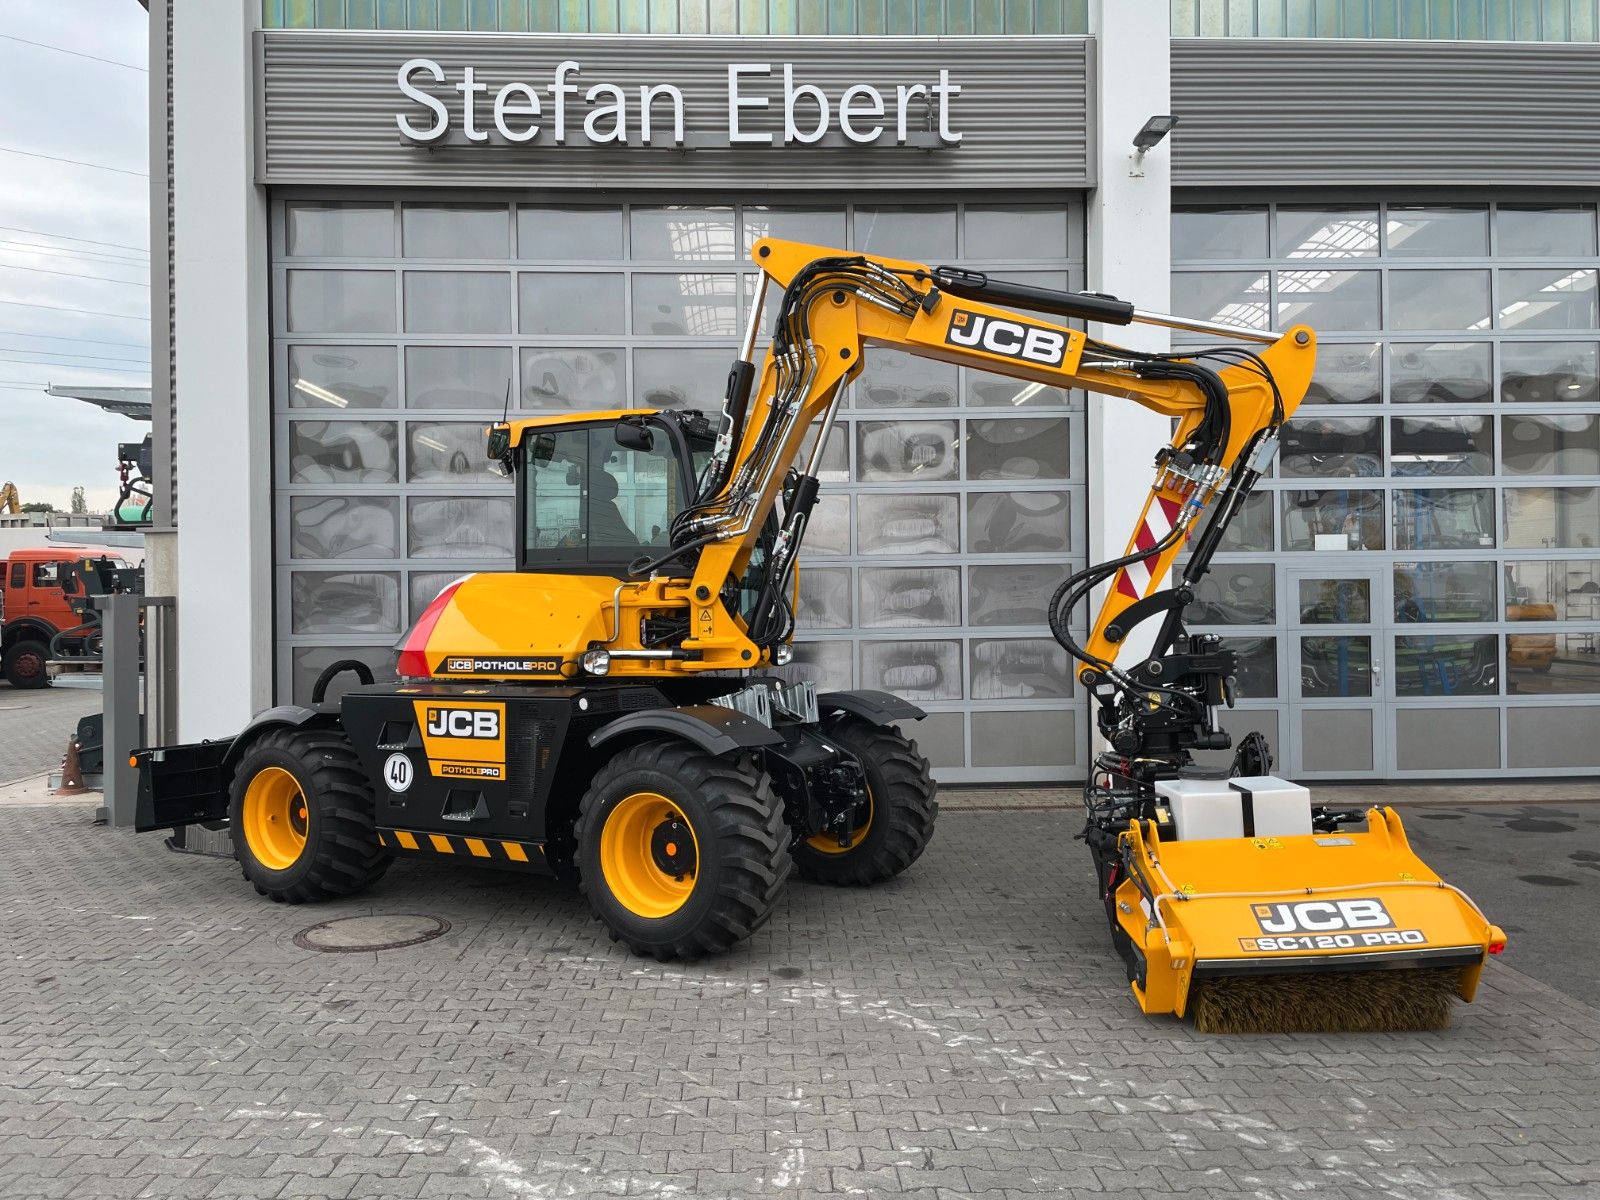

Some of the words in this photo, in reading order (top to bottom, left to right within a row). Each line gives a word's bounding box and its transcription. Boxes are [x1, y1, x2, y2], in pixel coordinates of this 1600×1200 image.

[395, 58, 684, 146] Stefan
[728, 62, 963, 146] Ebert
[950, 316, 1065, 364] JCB
[449, 661, 472, 670] JCB
[428, 710, 499, 738] JCB
[391, 760, 407, 784] 40
[1260, 900, 1391, 934] JCB
[1257, 934, 1355, 951] SC120
[1361, 930, 1425, 946] PRO
